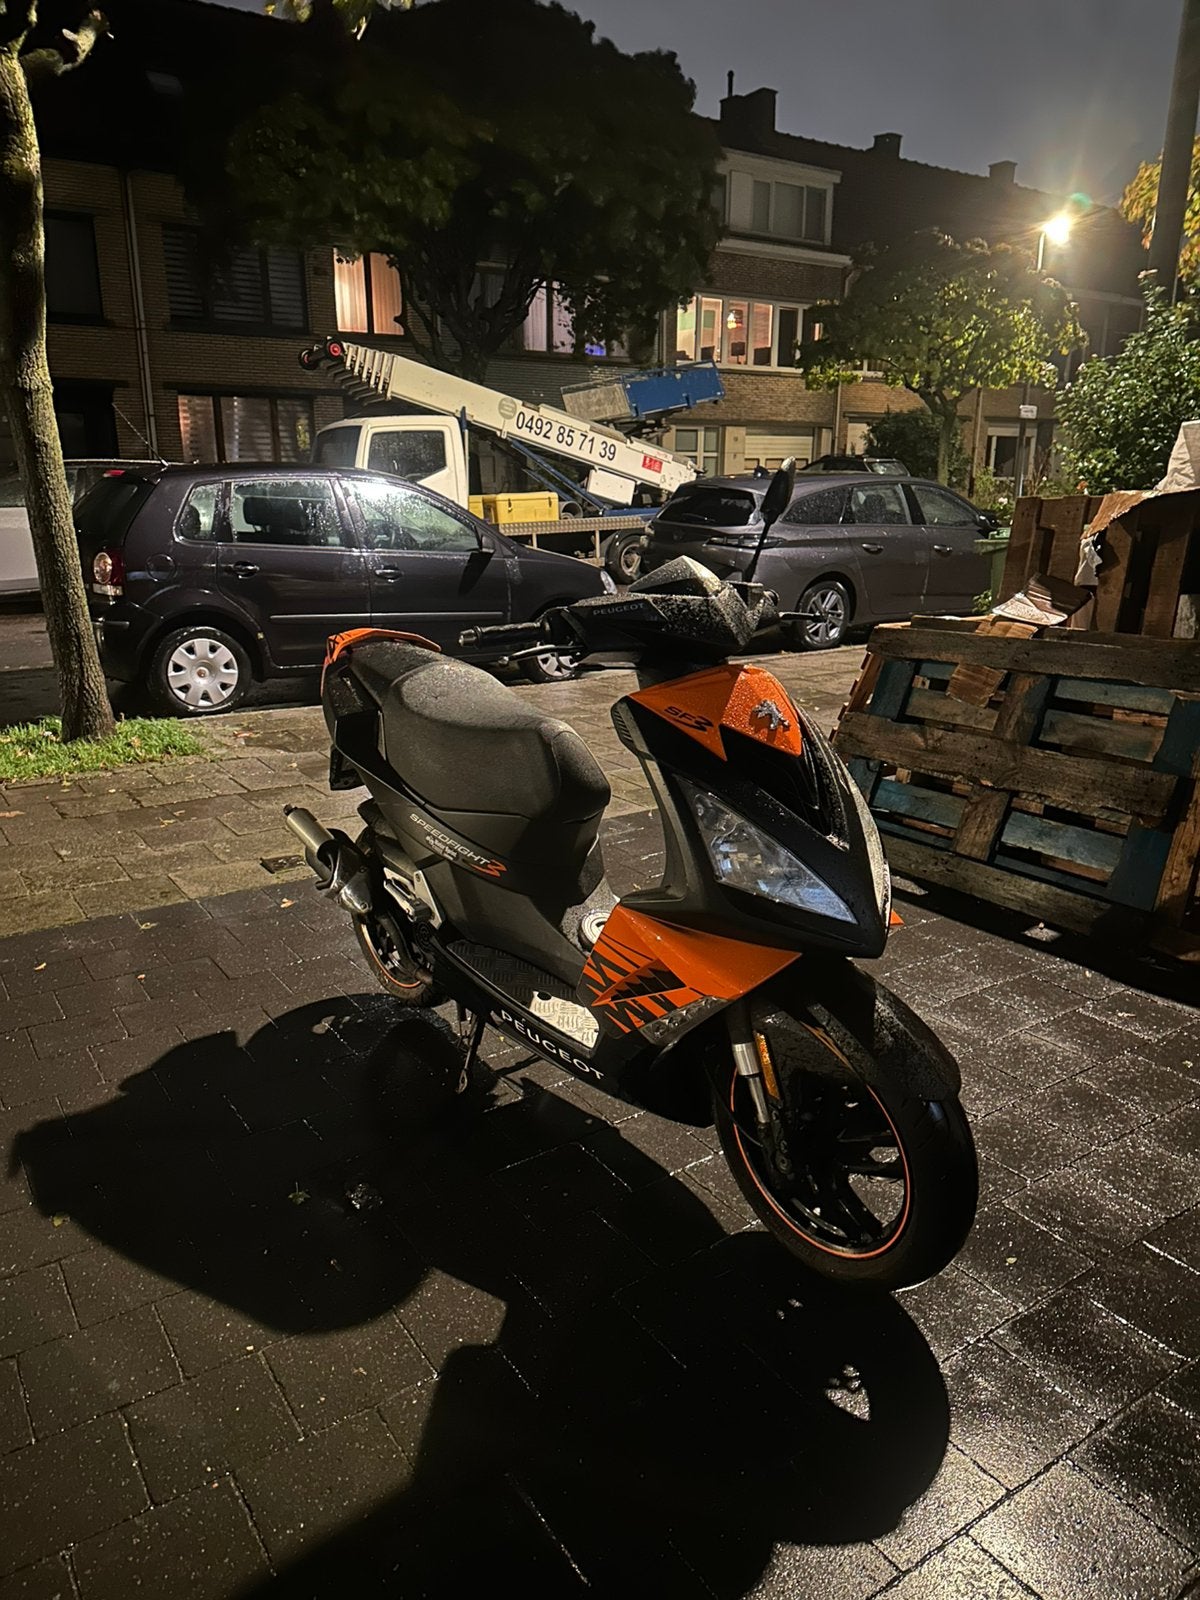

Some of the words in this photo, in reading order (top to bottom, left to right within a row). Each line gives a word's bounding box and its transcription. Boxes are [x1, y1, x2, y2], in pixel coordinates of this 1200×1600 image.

[516, 411, 553, 439] 0492
[556, 426, 575, 447] 85
[579, 433, 595, 454] 71
[599, 441, 617, 461] 39
[592, 602, 647, 615] PEUGEOT
[409, 813, 491, 865] SPEEDFIGHT
[501, 1009, 604, 1080] PEUGEOT
